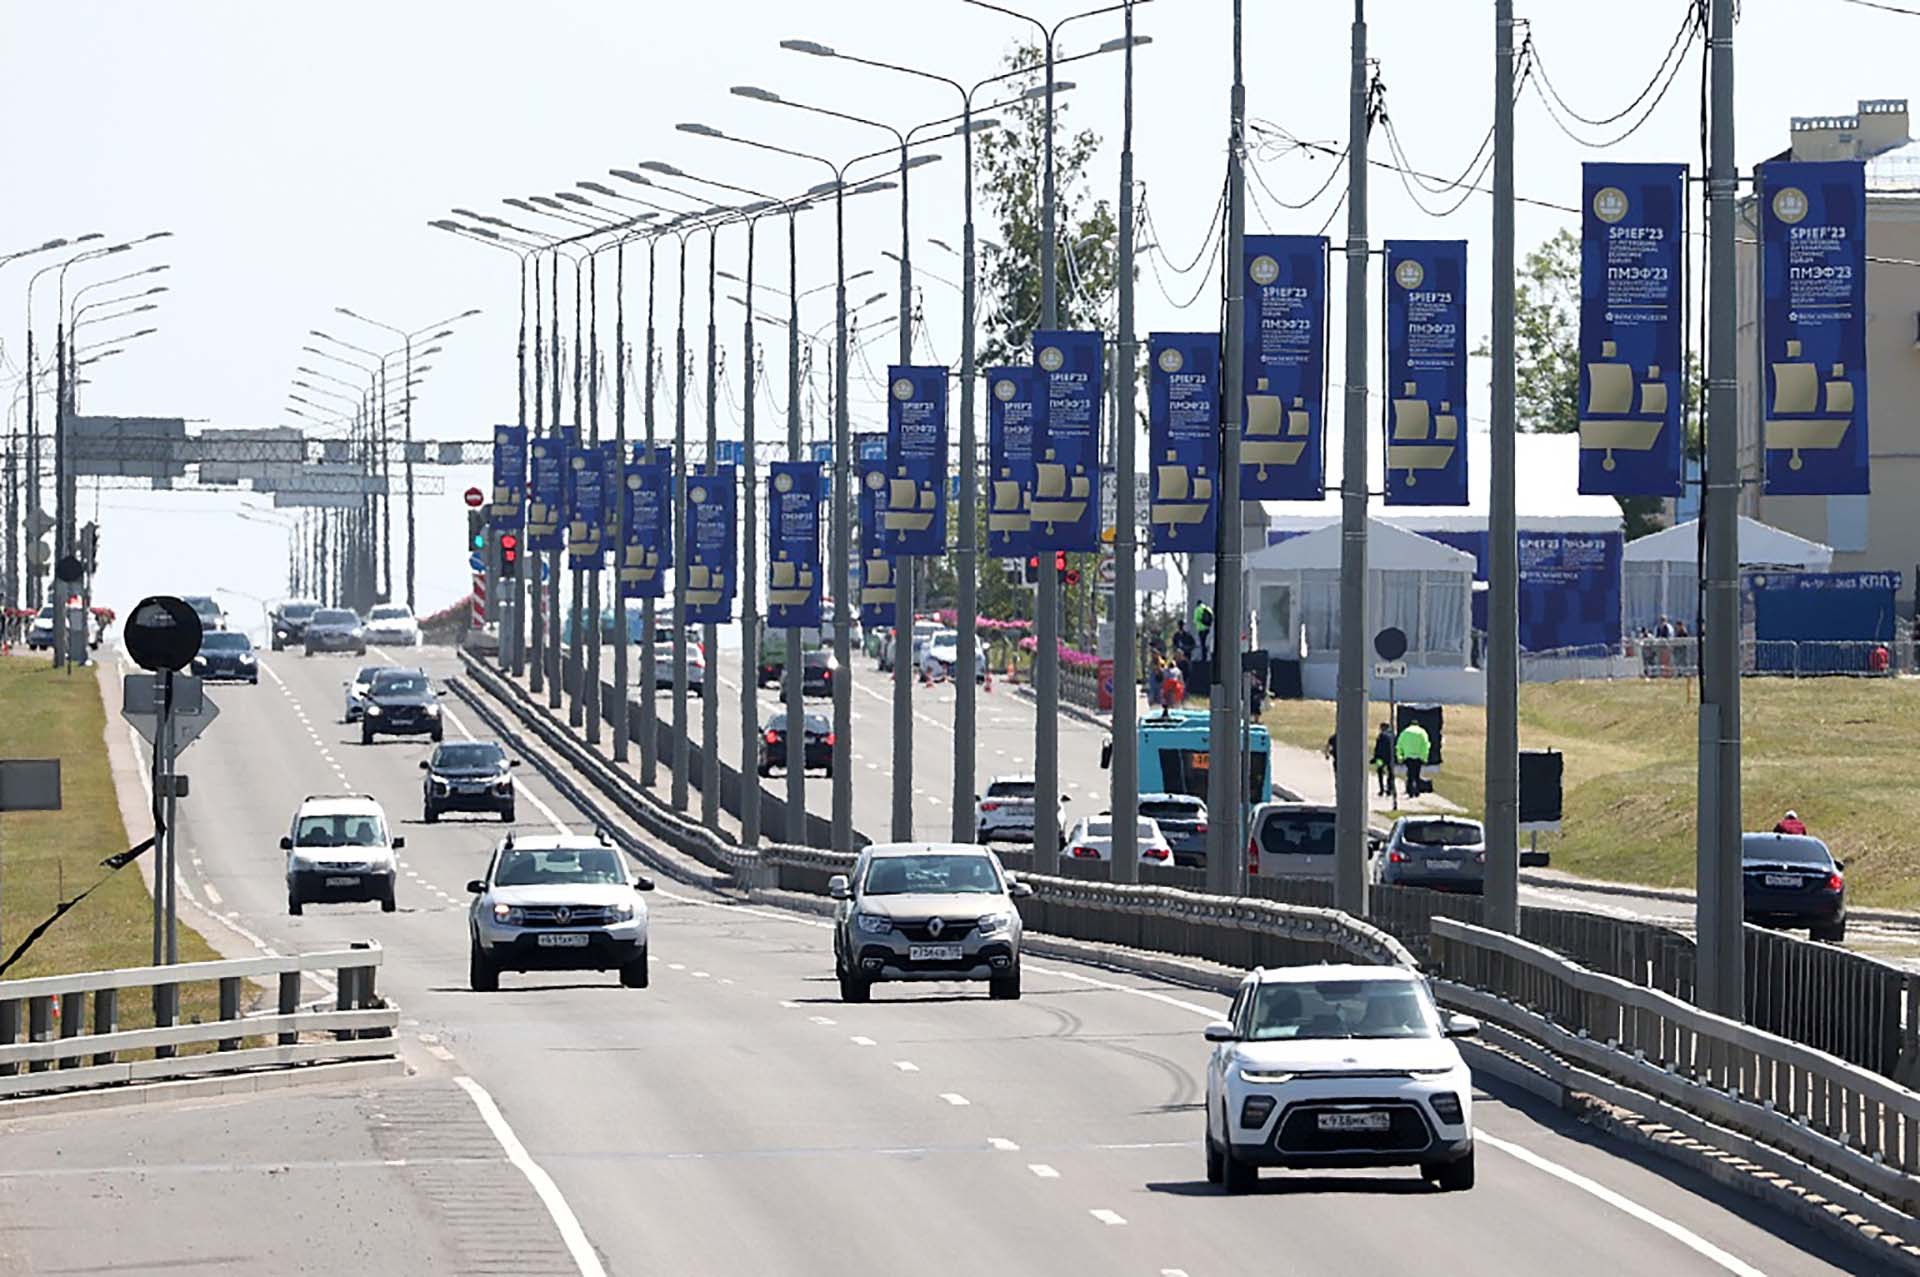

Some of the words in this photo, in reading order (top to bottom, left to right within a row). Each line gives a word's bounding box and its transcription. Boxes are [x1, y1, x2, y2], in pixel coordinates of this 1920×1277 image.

[1608, 227, 1665, 241] SPIEF'23
[1789, 227, 1847, 241] SPIEF'23
[1607, 266, 1669, 281] ПМЭФ'23
[1789, 266, 1853, 280] ПМЭФ'23
[1859, 574, 1891, 588] КПП
